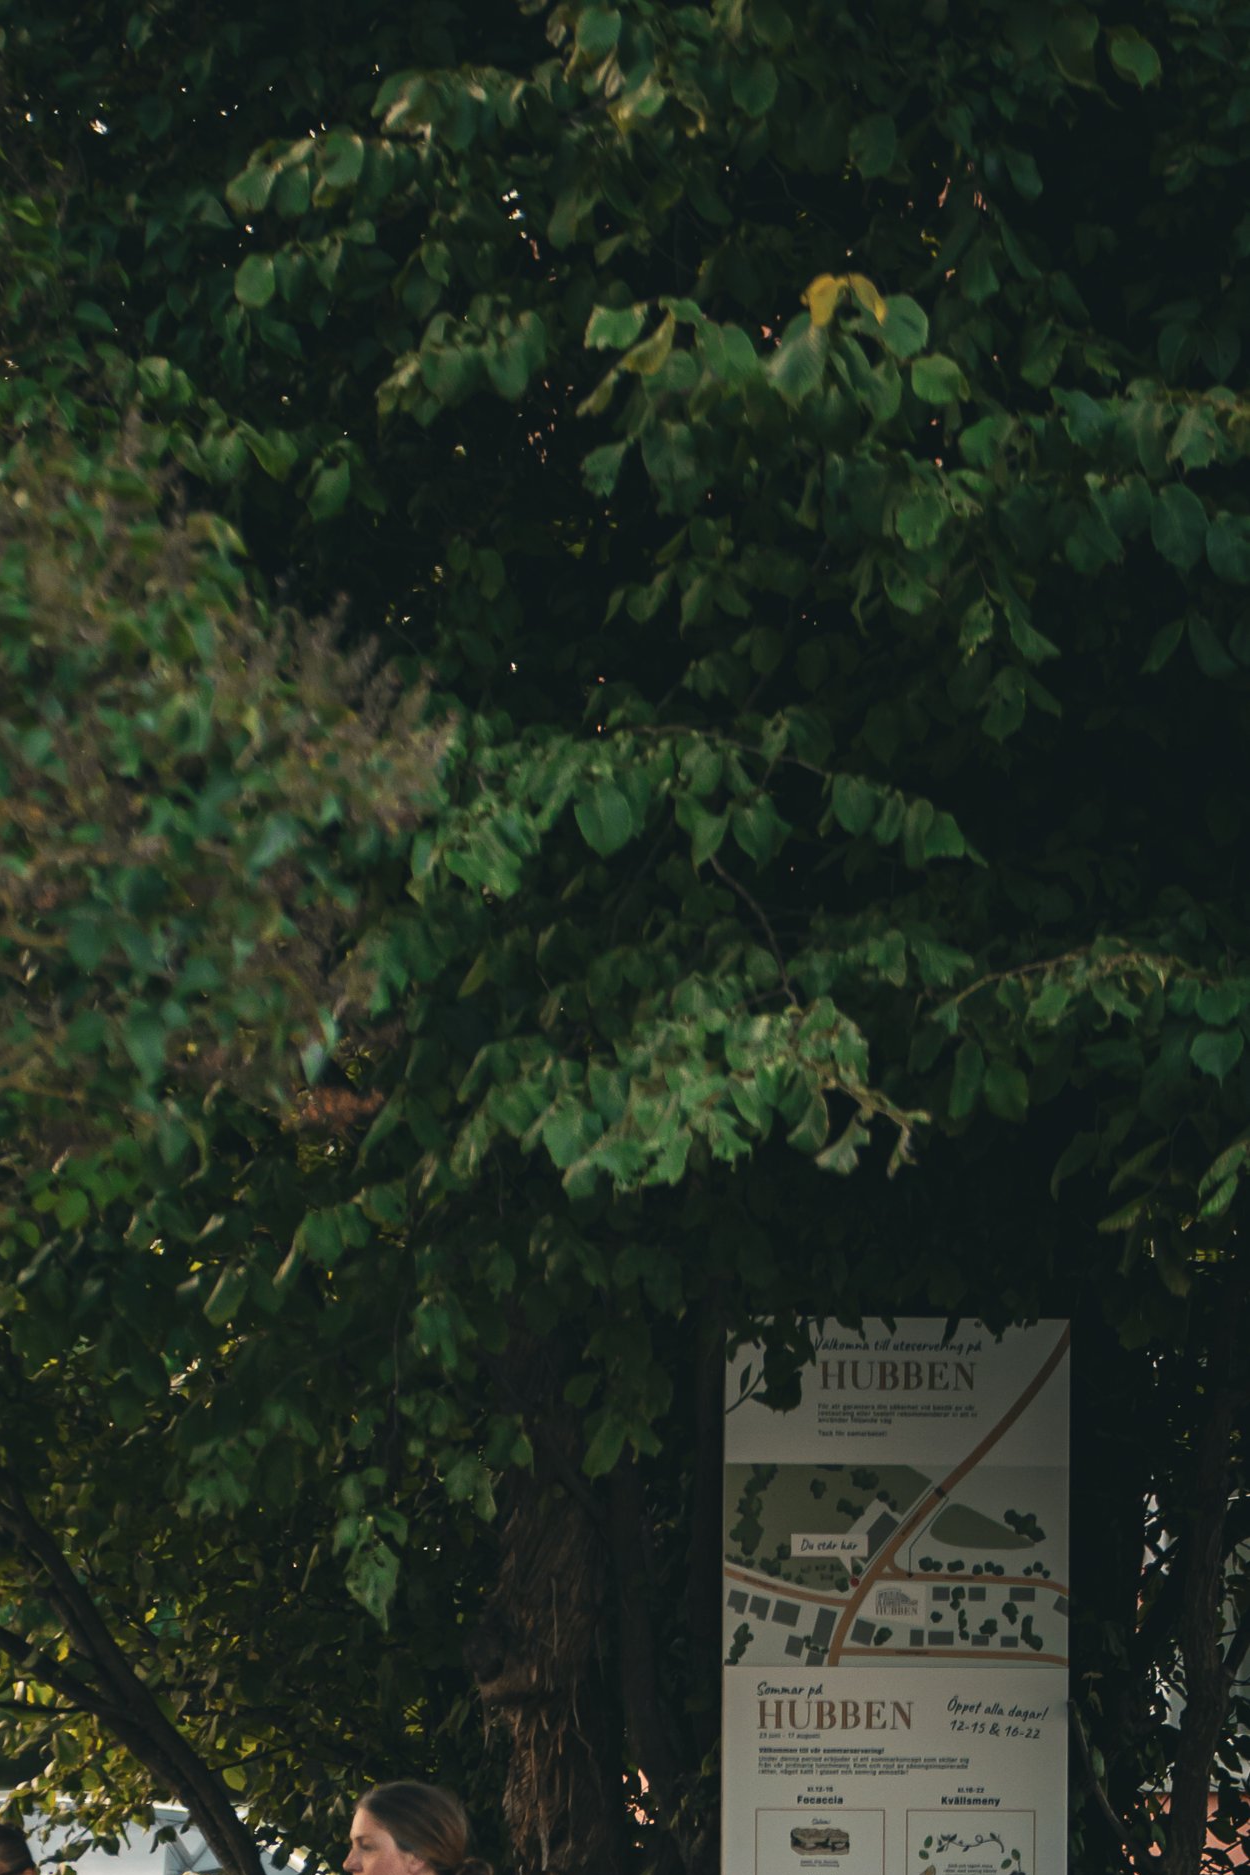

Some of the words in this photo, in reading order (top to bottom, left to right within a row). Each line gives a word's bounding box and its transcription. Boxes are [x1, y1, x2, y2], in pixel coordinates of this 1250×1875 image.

[874, 1338, 890, 1351] till
[965, 1339, 982, 1356] på
[820, 1360, 976, 1391] HUBBEN
[801, 1539, 813, 1551] Du
[876, 1607, 918, 1617] HUBBEN
[756, 1681, 804, 1696] Sommar
[808, 1683, 823, 1699] på
[757, 1699, 914, 1730] HUBBEN
[947, 1694, 982, 1715] Öppet
[984, 1702, 1004, 1716] alla
[1008, 1704, 1049, 1723] dagar!
[950, 1719, 986, 1734] 12-15
[989, 1722, 1000, 1737] &
[1005, 1725, 1041, 1739] 16-22
[797, 1795, 844, 1805] Focaccia
[941, 1796, 1001, 1808] Kvällsmeny
